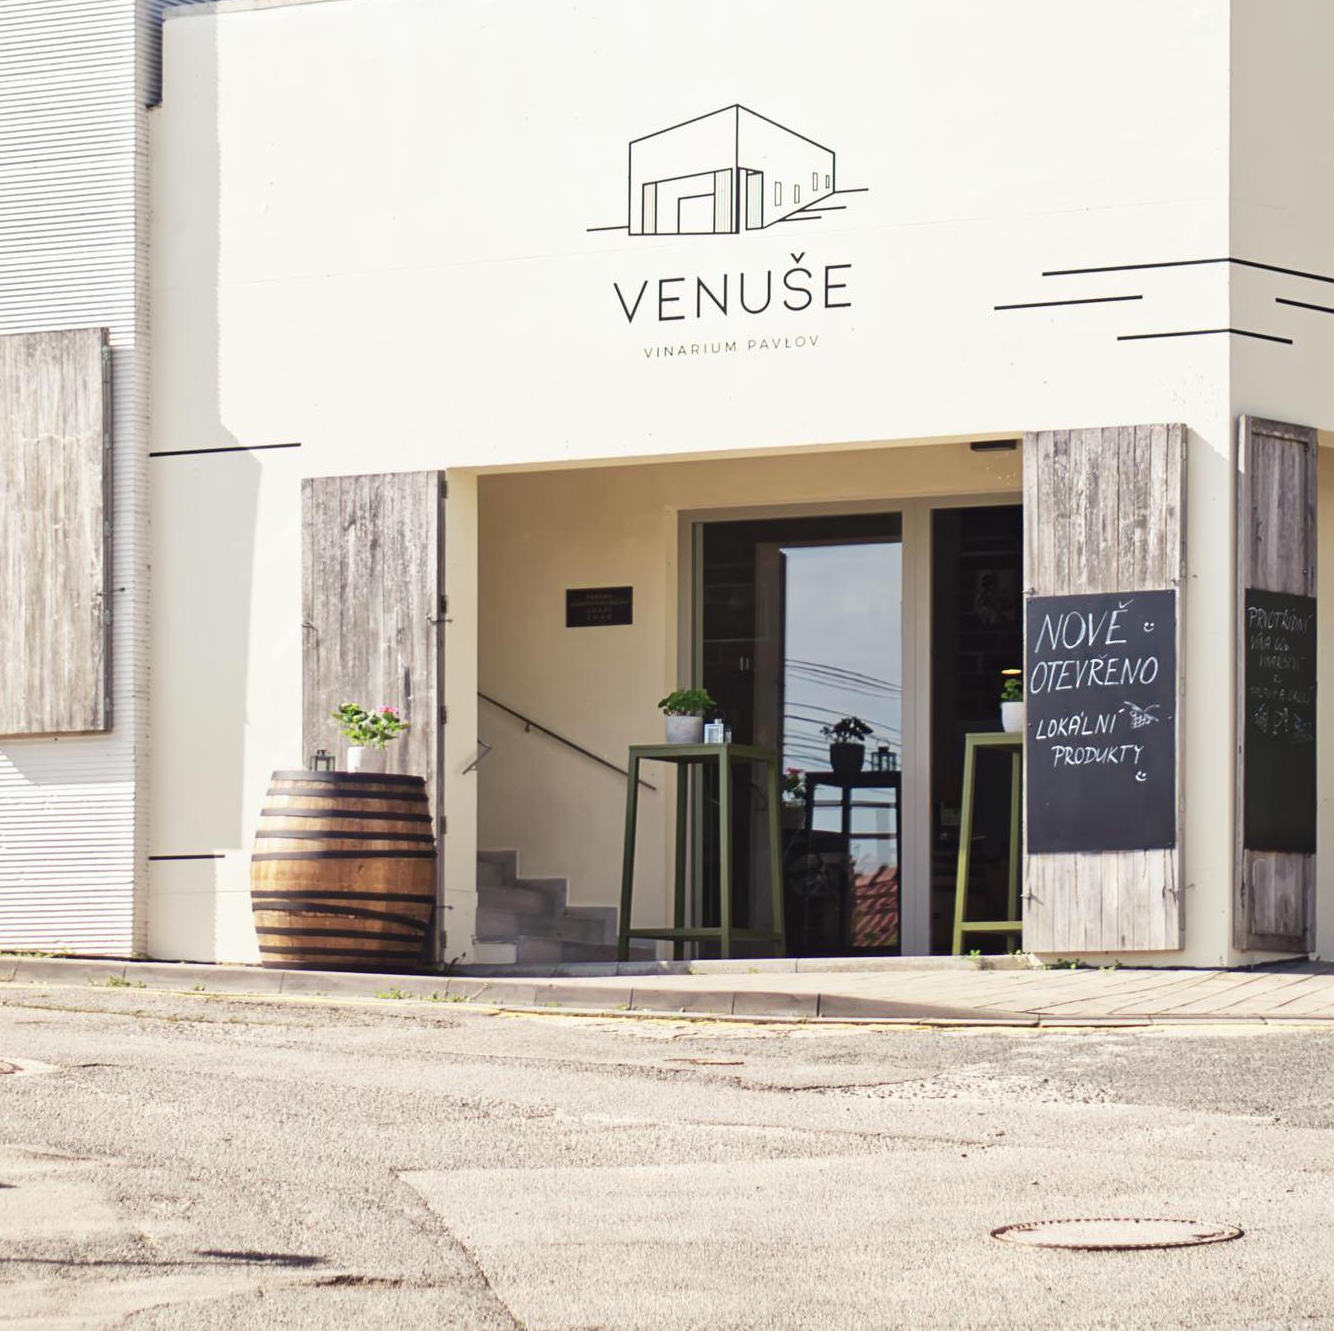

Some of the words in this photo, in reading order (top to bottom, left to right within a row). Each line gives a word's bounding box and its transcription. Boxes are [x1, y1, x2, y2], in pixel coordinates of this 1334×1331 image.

[613, 252, 852, 324] VENUŠE
[644, 341, 737, 358] VINARIUM
[748, 335, 819, 351] PAVLOV
[1034, 599, 1134, 653] NOVĚ
[1030, 654, 1158, 694] OTEVŘENO
[1036, 708, 1125, 739] LOKÁLNÍ
[1051, 744, 1144, 767] PRODUKTY
